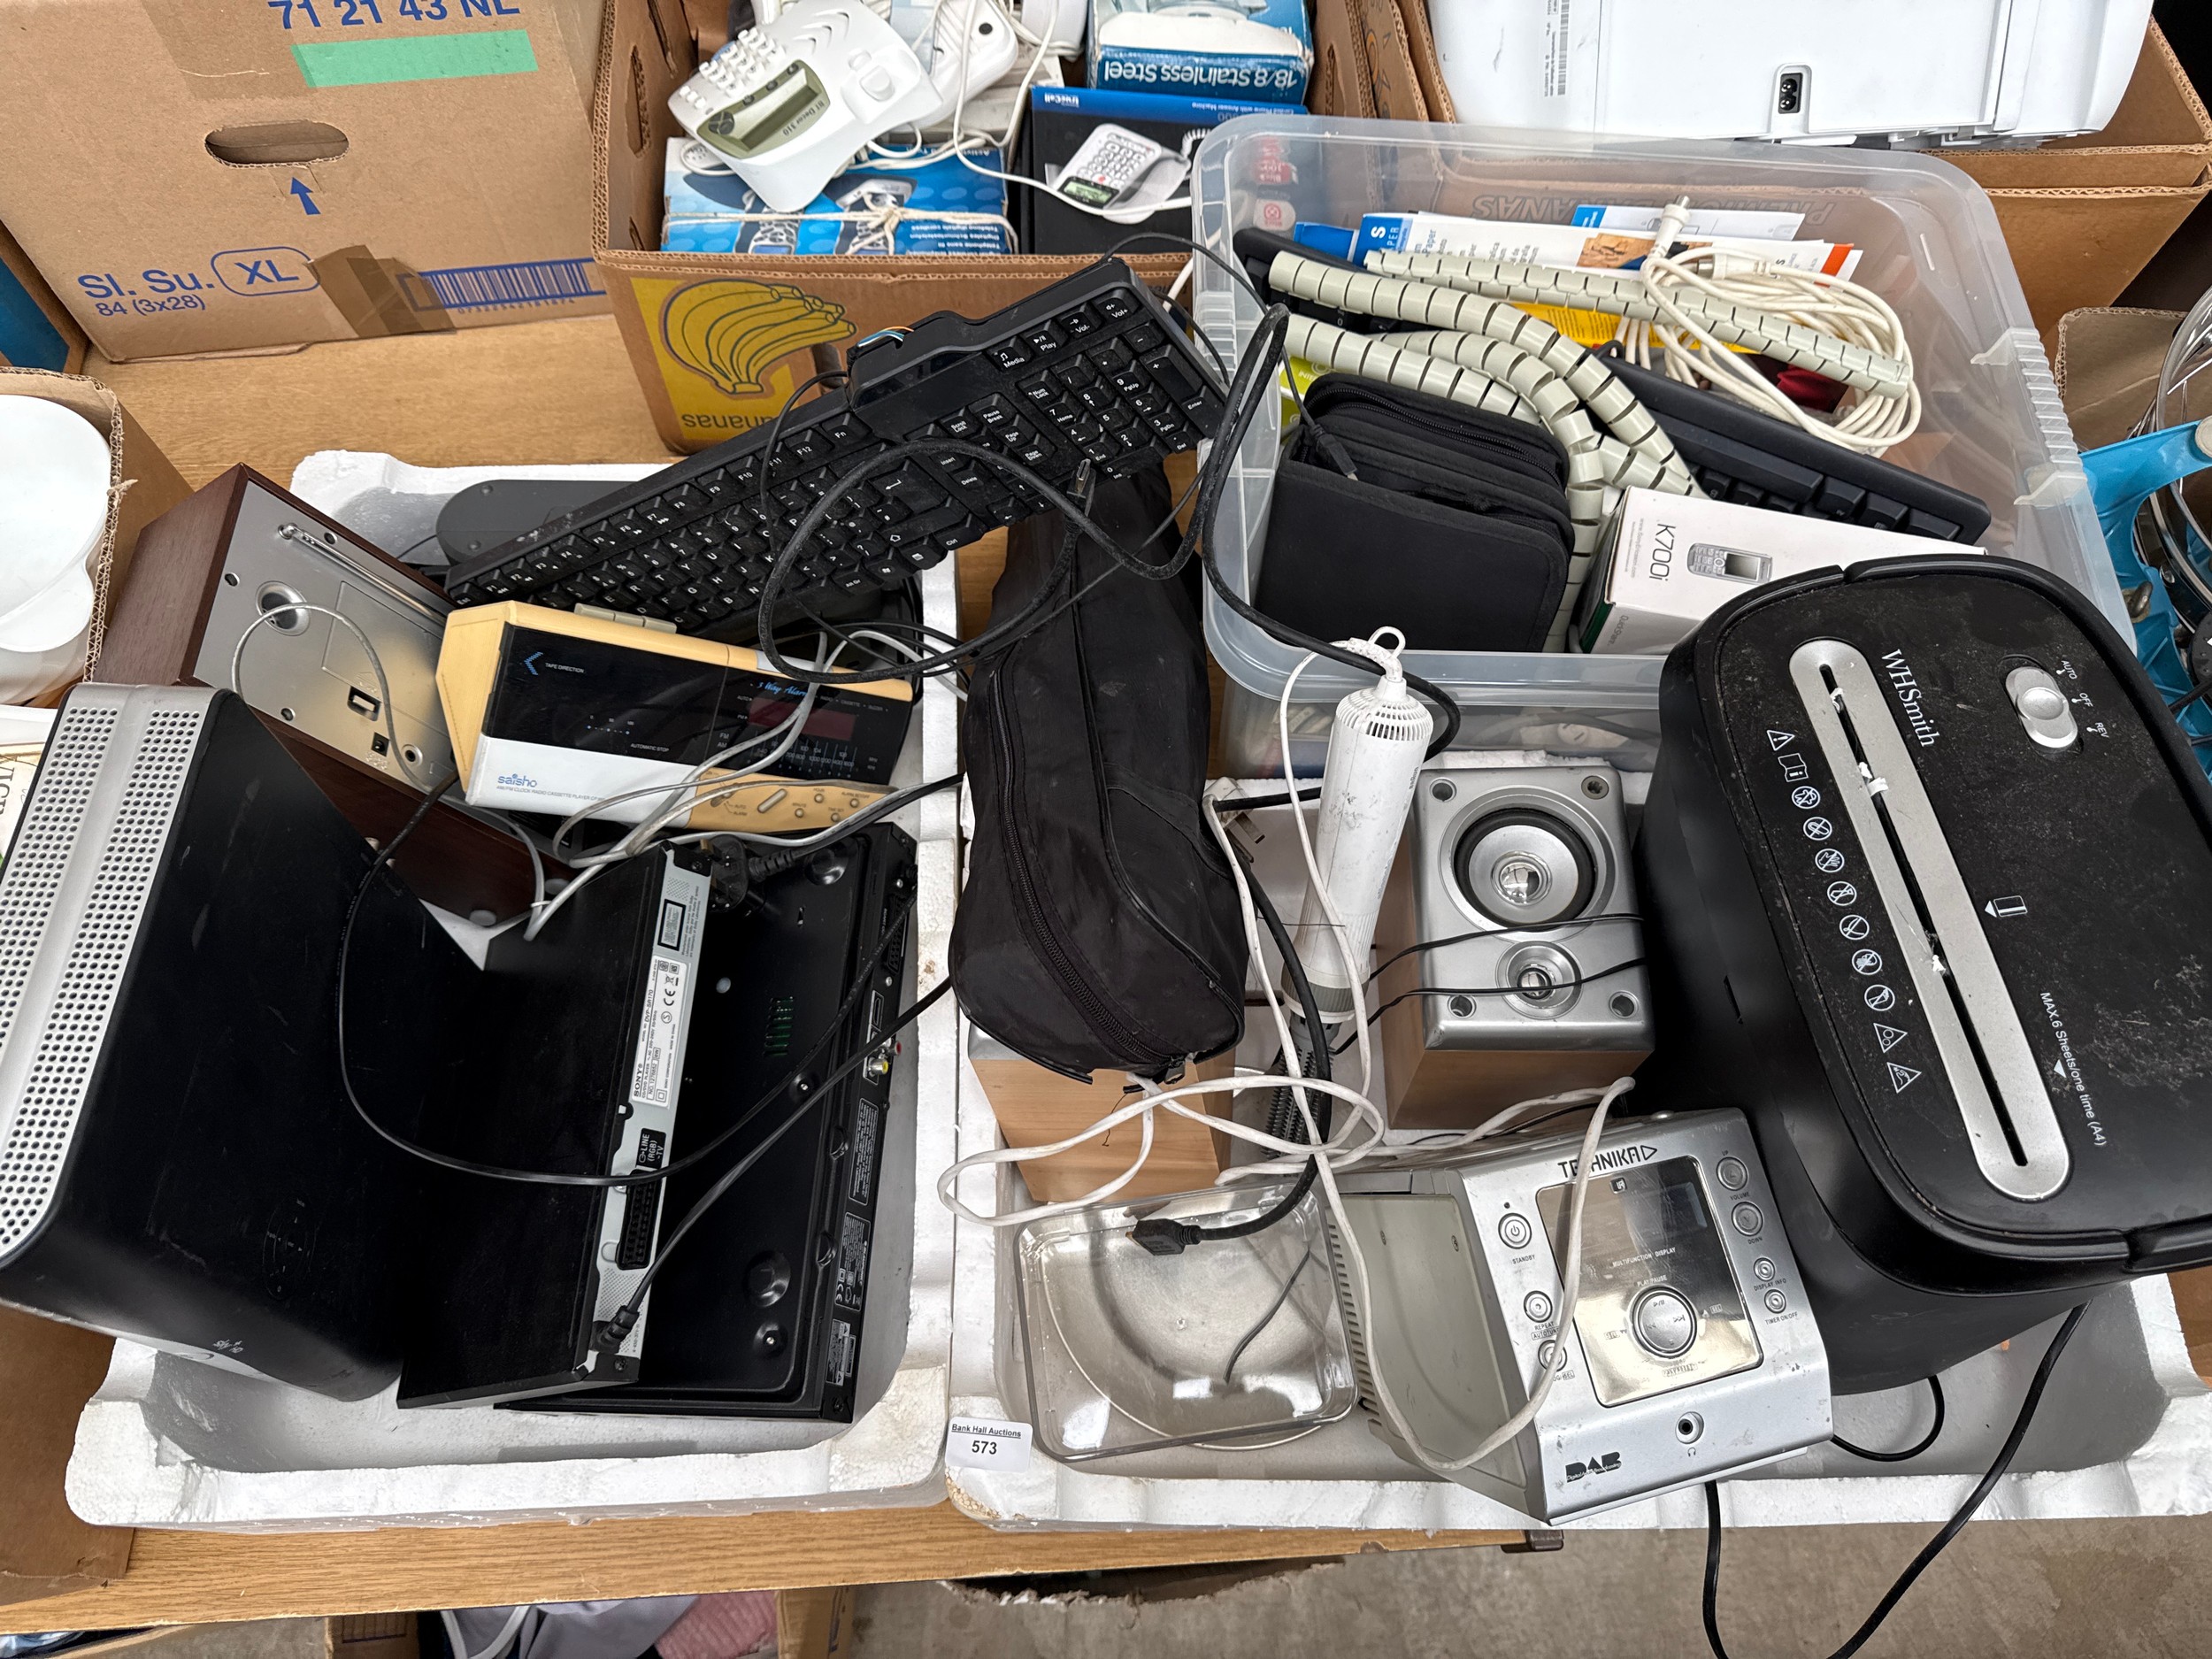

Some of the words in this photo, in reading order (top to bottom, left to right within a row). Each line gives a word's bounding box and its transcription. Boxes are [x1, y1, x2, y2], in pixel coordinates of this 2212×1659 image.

[268, 0, 321, 29] 71
[333, 0, 383, 26] 21
[398, 0, 448, 20] 43
[458, 0, 521, 18] NL
[1104, 60, 1157, 82] Steel
[1162, 63, 1249, 87] Stainless
[1256, 68, 1298, 89] 18/8
[142, 269, 216, 293] Su.
[234, 259, 300, 286] XL
[95, 301, 128, 317] 84
[132, 294, 205, 316] (3x28)
[1111, 307, 1128, 319] Vol+
[1075, 323, 1090, 334] Vol-
[1040, 341, 1056, 352] Play
[1003, 356, 1025, 368] Media
[1123, 383, 1139, 392] PgUp
[1187, 400, 1202, 410] Enter
[982, 410, 1000, 419] Pause
[1049, 408, 1056, 417] 7
[1057, 412, 1073, 422] Home
[987, 414, 1003, 424] Break
[950, 420, 966, 430] Scroll
[953, 425, 967, 434] Lock
[1159, 423, 1175, 433] PgDn
[1005, 430, 1019, 439] Page
[796, 446, 813, 456] F12
[768, 457, 782, 467] F11
[940, 457, 956, 465] Insert
[1027, 452, 1042, 462] Down
[738, 472, 753, 481] F10
[961, 476, 978, 486] Delete
[673, 501, 686, 510] F8
[1648, 522, 1677, 582] K700i
[711, 576, 723, 585] H
[629, 584, 641, 593] R
[749, 586, 759, 595] N
[604, 595, 615, 603] E
[557, 664, 585, 673] DIRECTION
[2061, 660, 2078, 680] AUTO
[764, 682, 781, 695] Way
[1881, 649, 1940, 748] WHSmith
[2078, 692, 2093, 708] OFF
[2094, 721, 2109, 739] REV
[630, 742, 656, 751] AUTOMATIC
[497, 773, 538, 787] saisho
[644, 989, 654, 1023] DVP-SR170
[634, 1067, 642, 1097] SONY
[2055, 1029, 2085, 1092] Sheets/one
[2078, 1092, 2096, 1119] time
[2087, 1120, 2107, 1147] (A4)
[641, 1133, 649, 1151] LINE
[647, 1140, 657, 1162] (RGB)
[1557, 1146, 1641, 1179] TEHNIKA
[1730, 1192, 1750, 1201] VOLUME
[1512, 1254, 1535, 1264] STANDBY
[1612, 1252, 1653, 1268] MULTIFUNCTION
[1655, 1247, 1676, 1257] DISPLAY
[1637, 1274, 1668, 1286] PLAY/PAUSE
[1753, 1282, 1774, 1292] DISPLAY
[1765, 1317, 1780, 1325] TIMER
[1780, 1311, 1799, 1321] ON/OFF
[1534, 1321, 1555, 1331] REPEAT
[988, 1427, 1021, 1438] Auctions
[972, 1440, 997, 1455] 573
[1565, 1451, 1622, 1483] DAB
